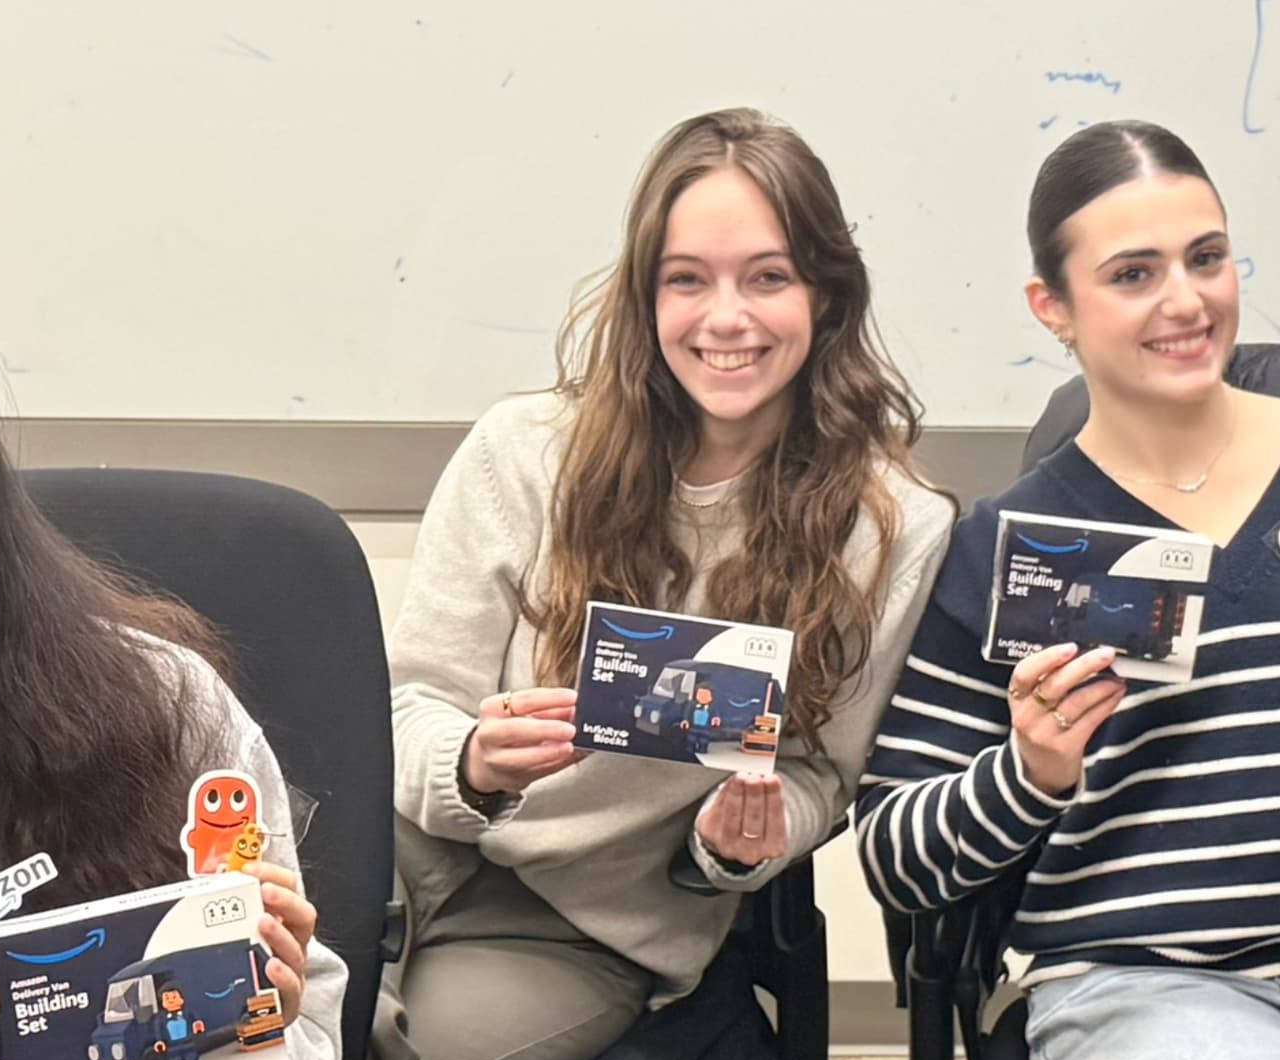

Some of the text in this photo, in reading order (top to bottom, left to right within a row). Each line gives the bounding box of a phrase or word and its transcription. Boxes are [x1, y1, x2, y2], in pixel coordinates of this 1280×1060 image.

[1007, 583, 1029, 597] Set
[1008, 571, 1063, 592] Building
[592, 668, 615, 683] Set
[594, 656, 649, 678] Building
[15, 992, 89, 1019] Building
[17, 1016, 48, 1036] Set
